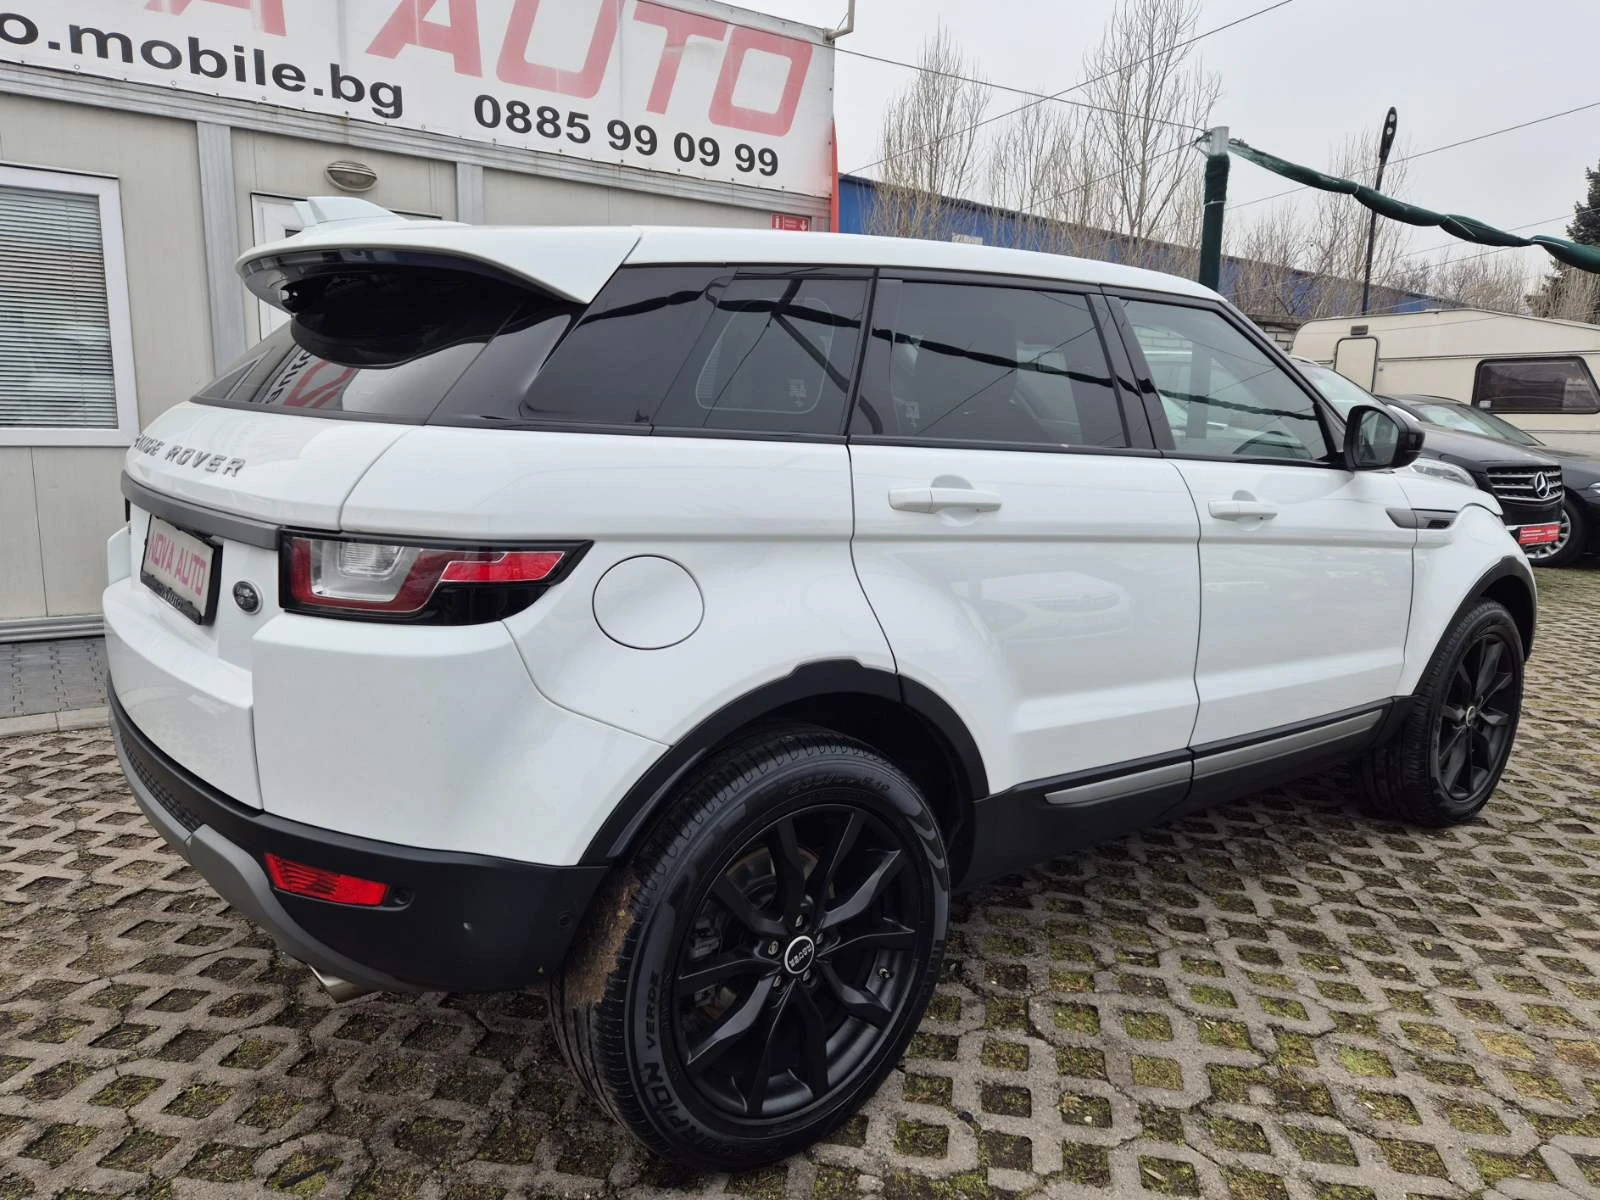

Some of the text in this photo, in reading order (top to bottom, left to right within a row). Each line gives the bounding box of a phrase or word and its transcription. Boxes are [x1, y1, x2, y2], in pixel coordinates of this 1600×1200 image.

[0, 12, 403, 119] o.mobile.bg
[365, 0, 814, 138] AUTO
[473, 94, 779, 177] 0885 99 09 99
[165, 444, 246, 478] ROVER
[147, 529, 207, 597] NOVA AUTO
